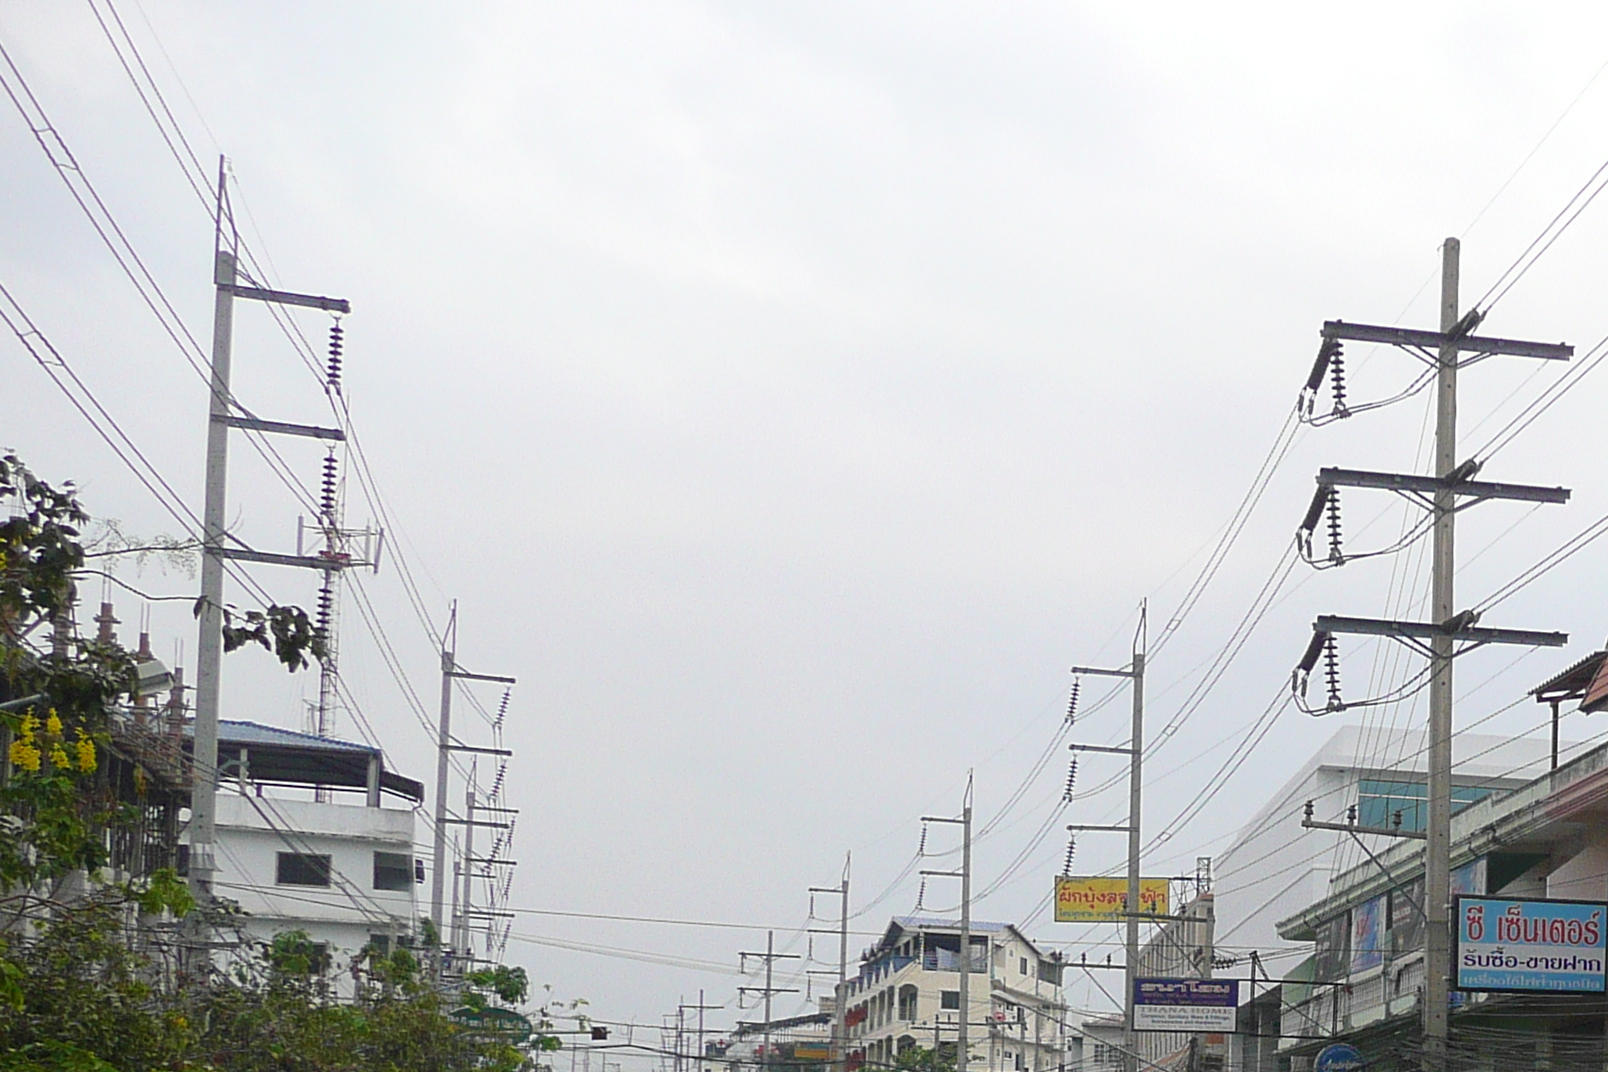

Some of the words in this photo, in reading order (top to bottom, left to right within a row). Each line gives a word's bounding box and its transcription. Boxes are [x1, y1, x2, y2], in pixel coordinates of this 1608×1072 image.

[1059, 886, 1165, 909] ผักบุ้งลอฟ้า
[1467, 905, 1484, 941] ซี
[1497, 904, 1600, 945] เซ็นเตอร์
